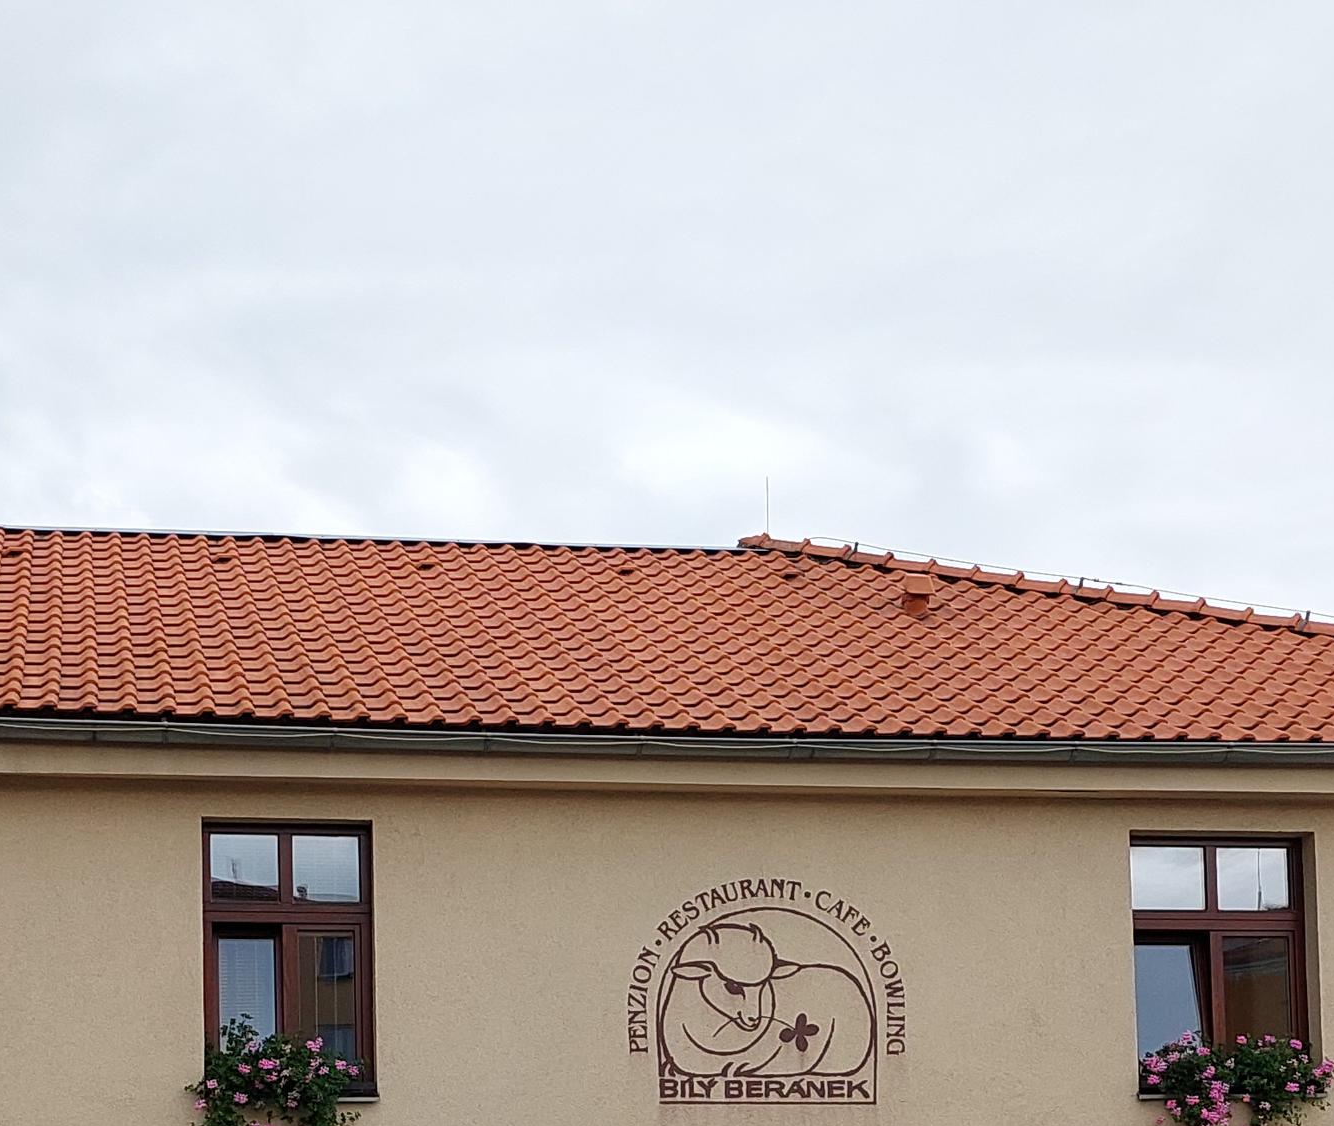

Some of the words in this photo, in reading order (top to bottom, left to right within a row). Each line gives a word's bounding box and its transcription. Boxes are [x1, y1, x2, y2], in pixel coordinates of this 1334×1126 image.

[627, 946, 661, 1054] PENZION
[657, 878, 801, 942] RESTAURANT
[815, 891, 871, 937] CAFE
[871, 940, 906, 1056] BOWLING
[724, 1077, 870, 1099] BERÁNEK
